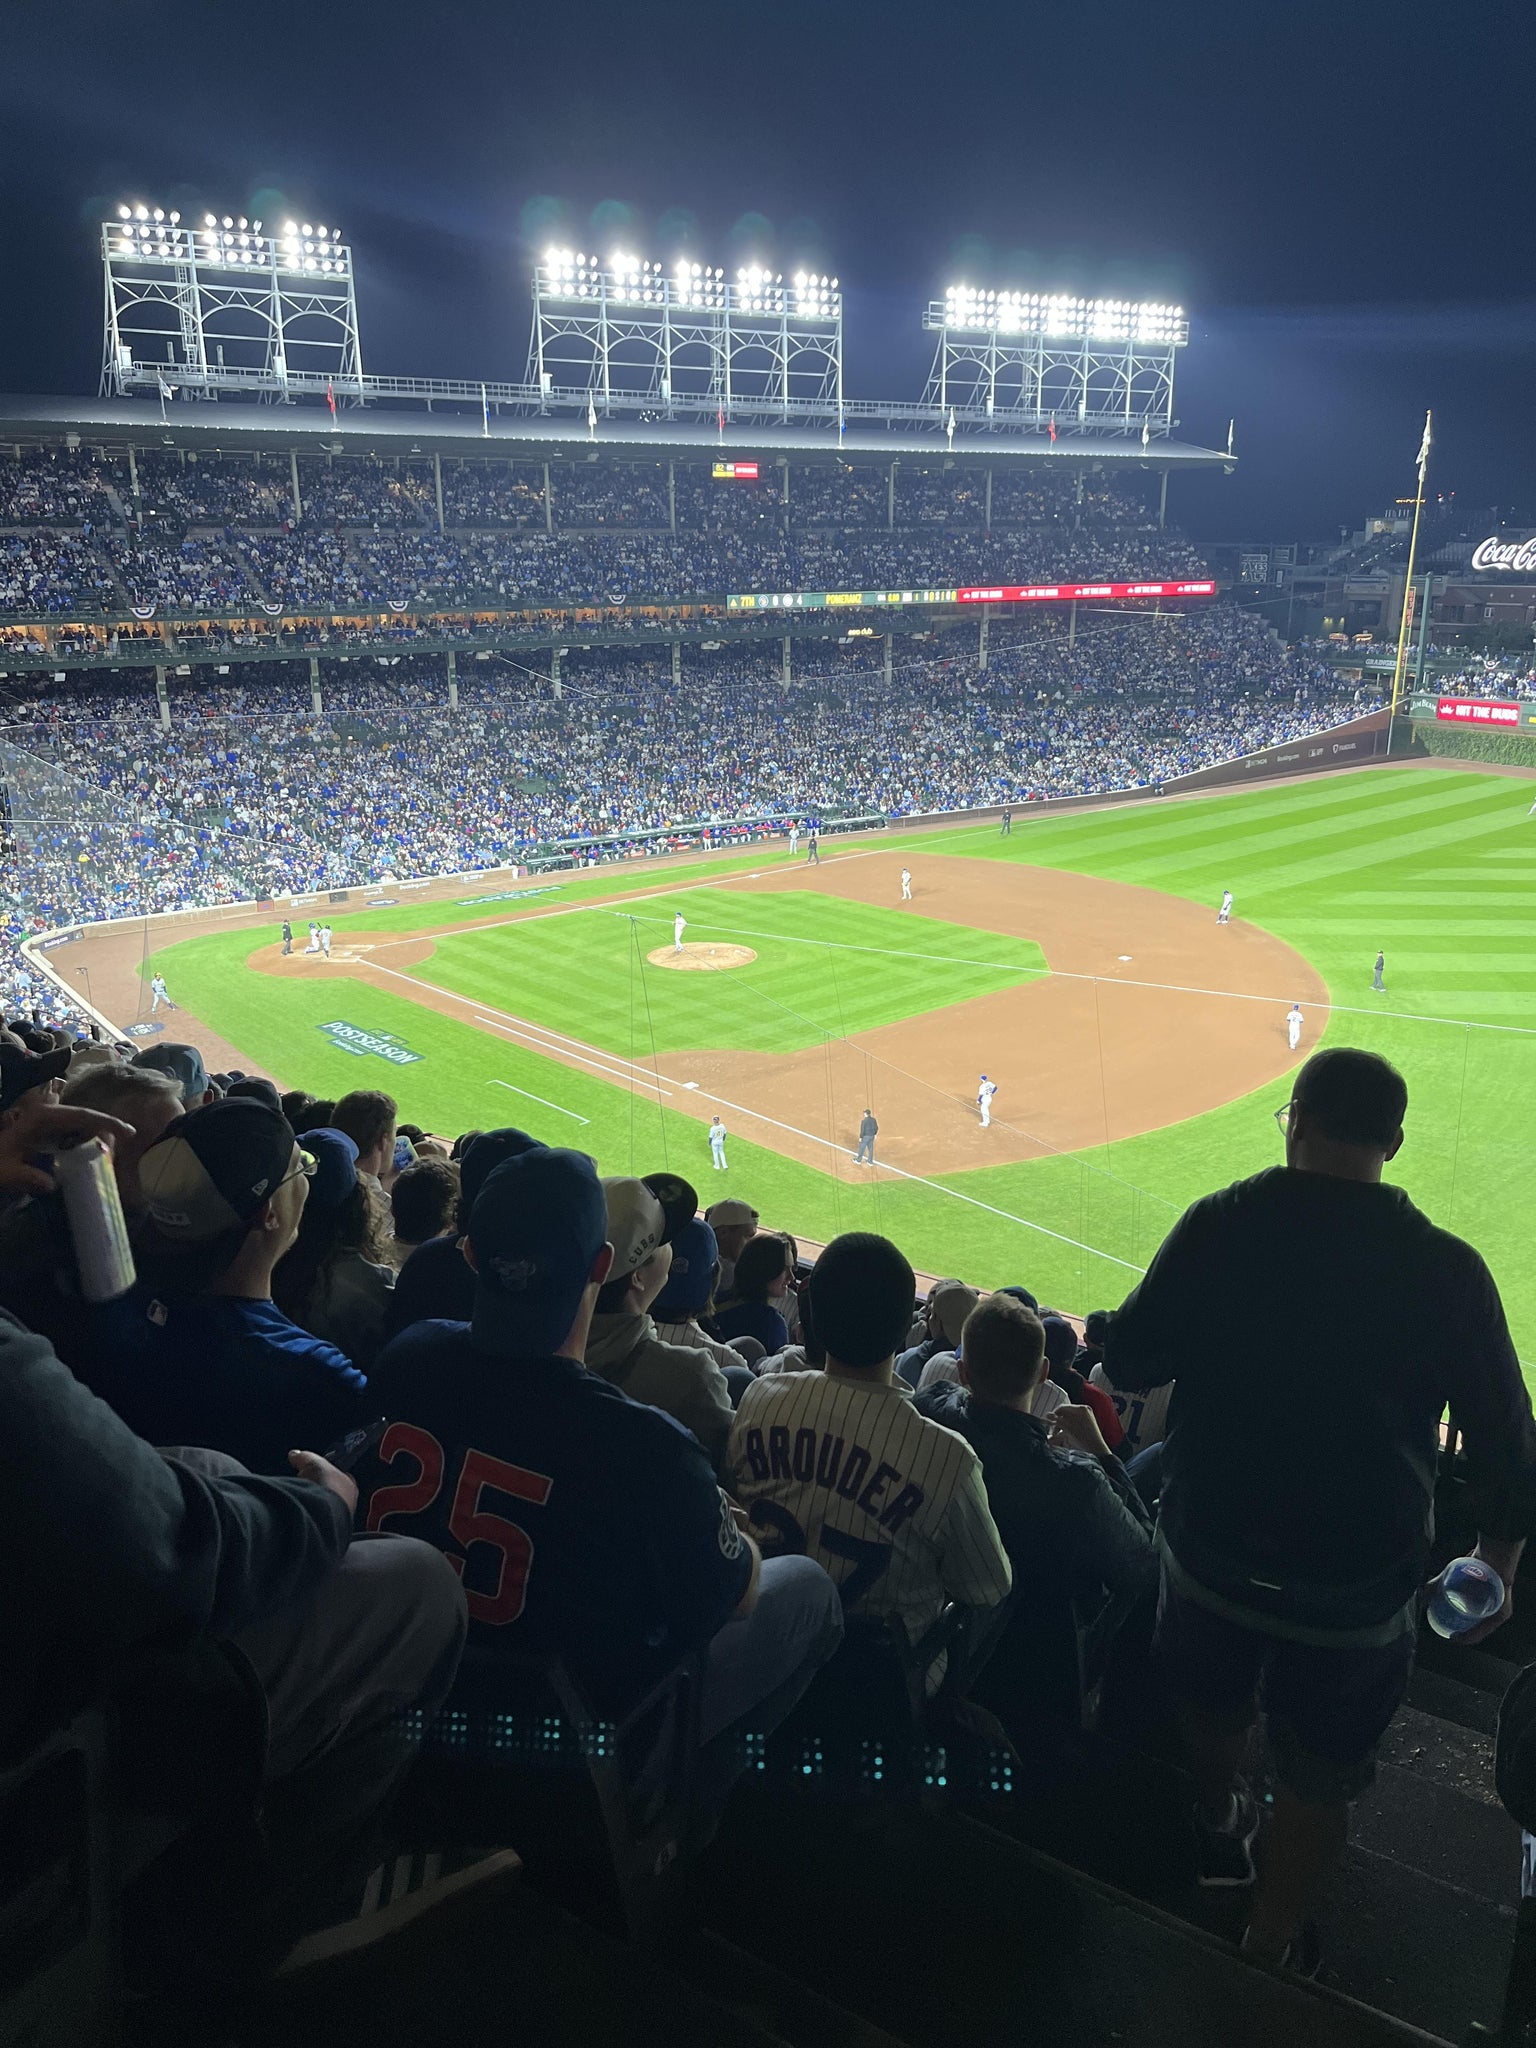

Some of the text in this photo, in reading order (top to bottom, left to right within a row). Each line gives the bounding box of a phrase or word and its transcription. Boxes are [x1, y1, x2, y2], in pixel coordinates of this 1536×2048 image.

[741, 597, 755, 607] 7TH
[796, 595, 803, 605] 4
[825, 594, 862, 605] POMERANZ
[1422, 699, 1437, 713] BEAM
[1455, 705, 1519, 720] HIT THE BUDS
[321, 1021, 419, 1064] POSTSEASON
[628, 1233, 656, 1265] CUBS
[747, 1425, 924, 1536] BROUDER
[366, 1421, 553, 1625] 25
